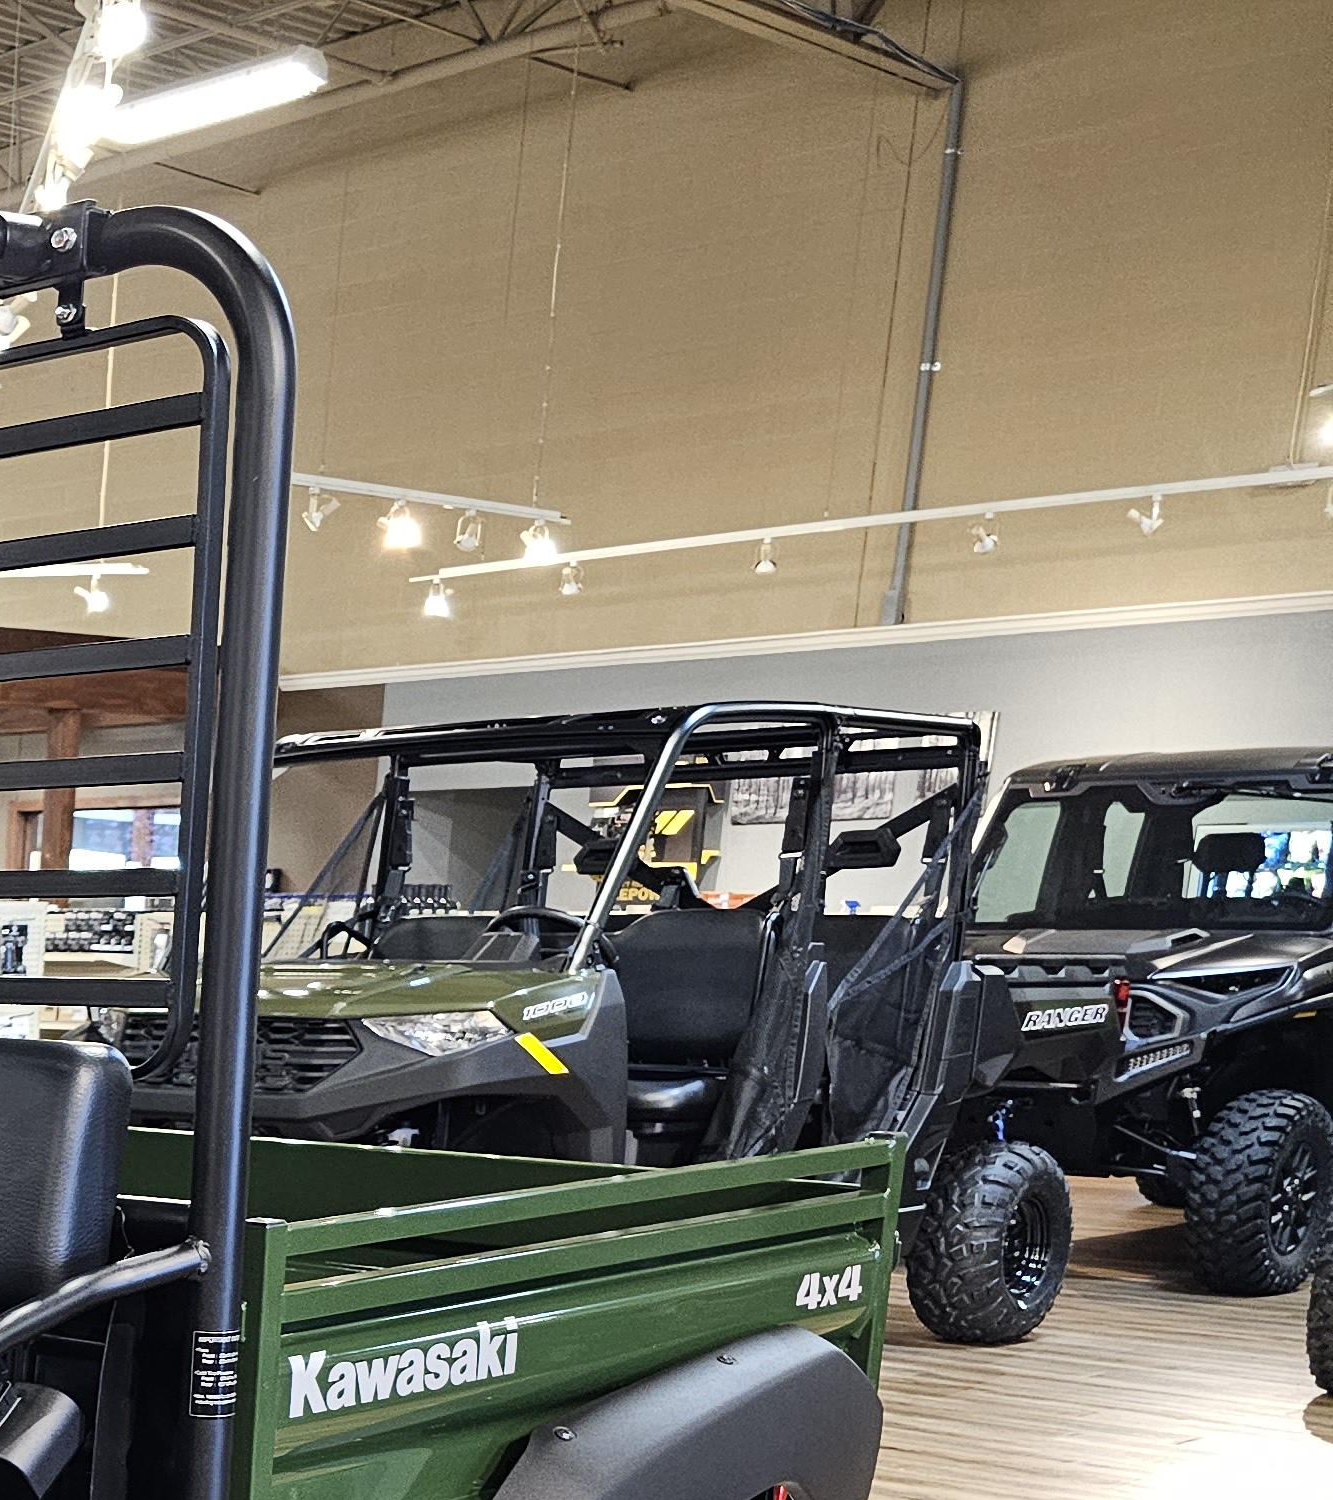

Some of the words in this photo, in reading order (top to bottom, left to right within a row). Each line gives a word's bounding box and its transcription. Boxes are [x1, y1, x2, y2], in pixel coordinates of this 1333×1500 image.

[1021, 1004, 1109, 1032] RANGER
[795, 1264, 863, 1310] 4x4
[288, 1316, 519, 1419] Kawasaki
